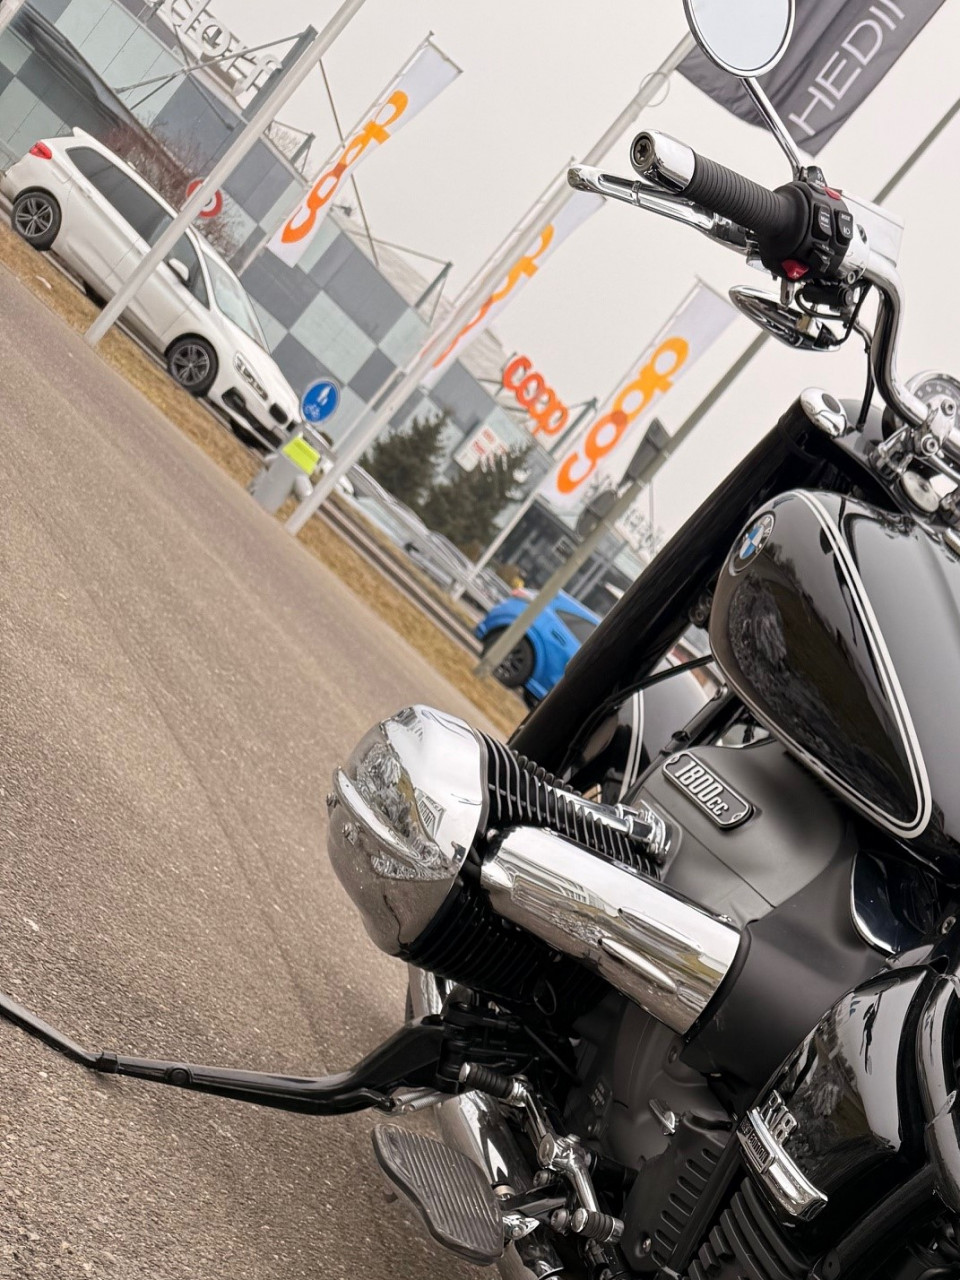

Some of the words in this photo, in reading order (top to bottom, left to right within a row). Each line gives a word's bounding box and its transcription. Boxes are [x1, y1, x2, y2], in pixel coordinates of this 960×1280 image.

[281, 90, 409, 244] coop
[502, 354, 569, 437] coop
[556, 336, 690, 495] coop
[674, 760, 729, 816] 1800cc
